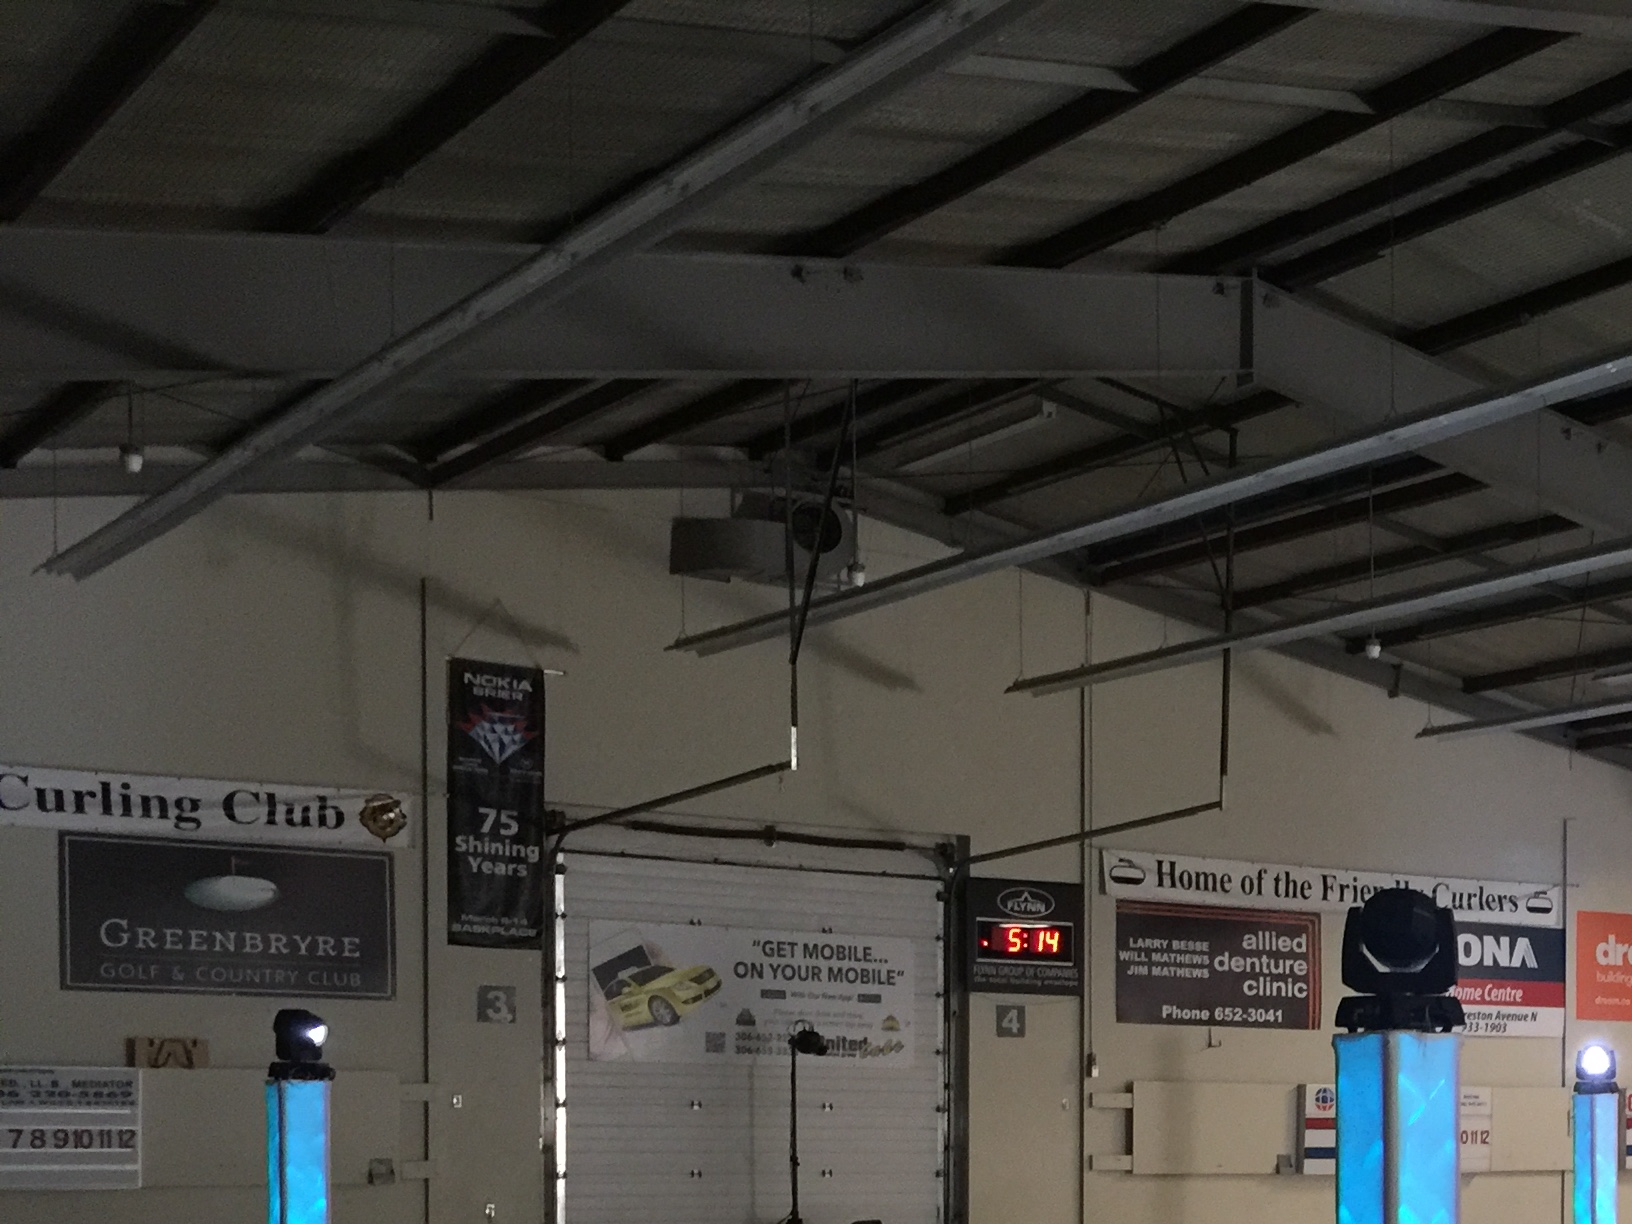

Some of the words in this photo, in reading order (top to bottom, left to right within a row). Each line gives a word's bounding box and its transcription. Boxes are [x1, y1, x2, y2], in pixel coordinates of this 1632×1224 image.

[463, 672, 533, 692] NOKIA
[0, 773, 202, 831] Curling
[222, 789, 345, 830] Club
[478, 807, 519, 835] 75
[455, 835, 540, 863] Shining
[468, 856, 528, 877] Years
[1156, 859, 1232, 894] Home
[1240, 868, 1267, 896] of
[1273, 871, 1312, 900] the
[1432, 882, 1519, 913] Curlers
[1007, 899, 1046, 913] FLYNN
[100, 918, 361, 957] GREENBRYRE
[1008, 928, 1060, 953] 5:14
[1129, 937, 1169, 950] LARRY
[1242, 930, 1307, 953] allied
[1119, 951, 1148, 962] WILL
[1151, 952, 1210, 965] MATHEWS
[1457, 933, 1538, 968] ONA
[100, 962, 159, 980] GOLF
[171, 966, 185, 981] &
[196, 966, 298, 984] COUNTRY
[307, 971, 361, 987] CLUB
[734, 962, 764, 980] ON
[769, 963, 822, 983] YOUR
[1127, 965, 1148, 976] JIM
[1151, 966, 1210, 979] MATHEWS
[1213, 952, 1308, 976] denture
[1243, 976, 1308, 999] clinic
[1596, 971, 1632, 988] building
[1484, 984, 1523, 1002] Centre
[1001, 1009, 1020, 1034] 4
[1162, 1005, 1210, 1021] Phone
[1214, 1007, 1283, 1023] 652-3041
[1464, 1011, 1493, 1021] reston
[1495, 1010, 1528, 1022] Avenue
[1530, 1011, 1538, 1022] N
[822, 1036, 868, 1051] nited
[8, 1128, 24, 1149] 7
[30, 1128, 46, 1149] 8
[53, 1128, 69, 1149] 9
[73, 1128, 94, 1149] 10
[99, 1128, 112, 1149] 11
[117, 1128, 136, 1149] 12
[1471, 1130, 1478, 1144] 11
[1480, 1130, 1490, 1144] 12
